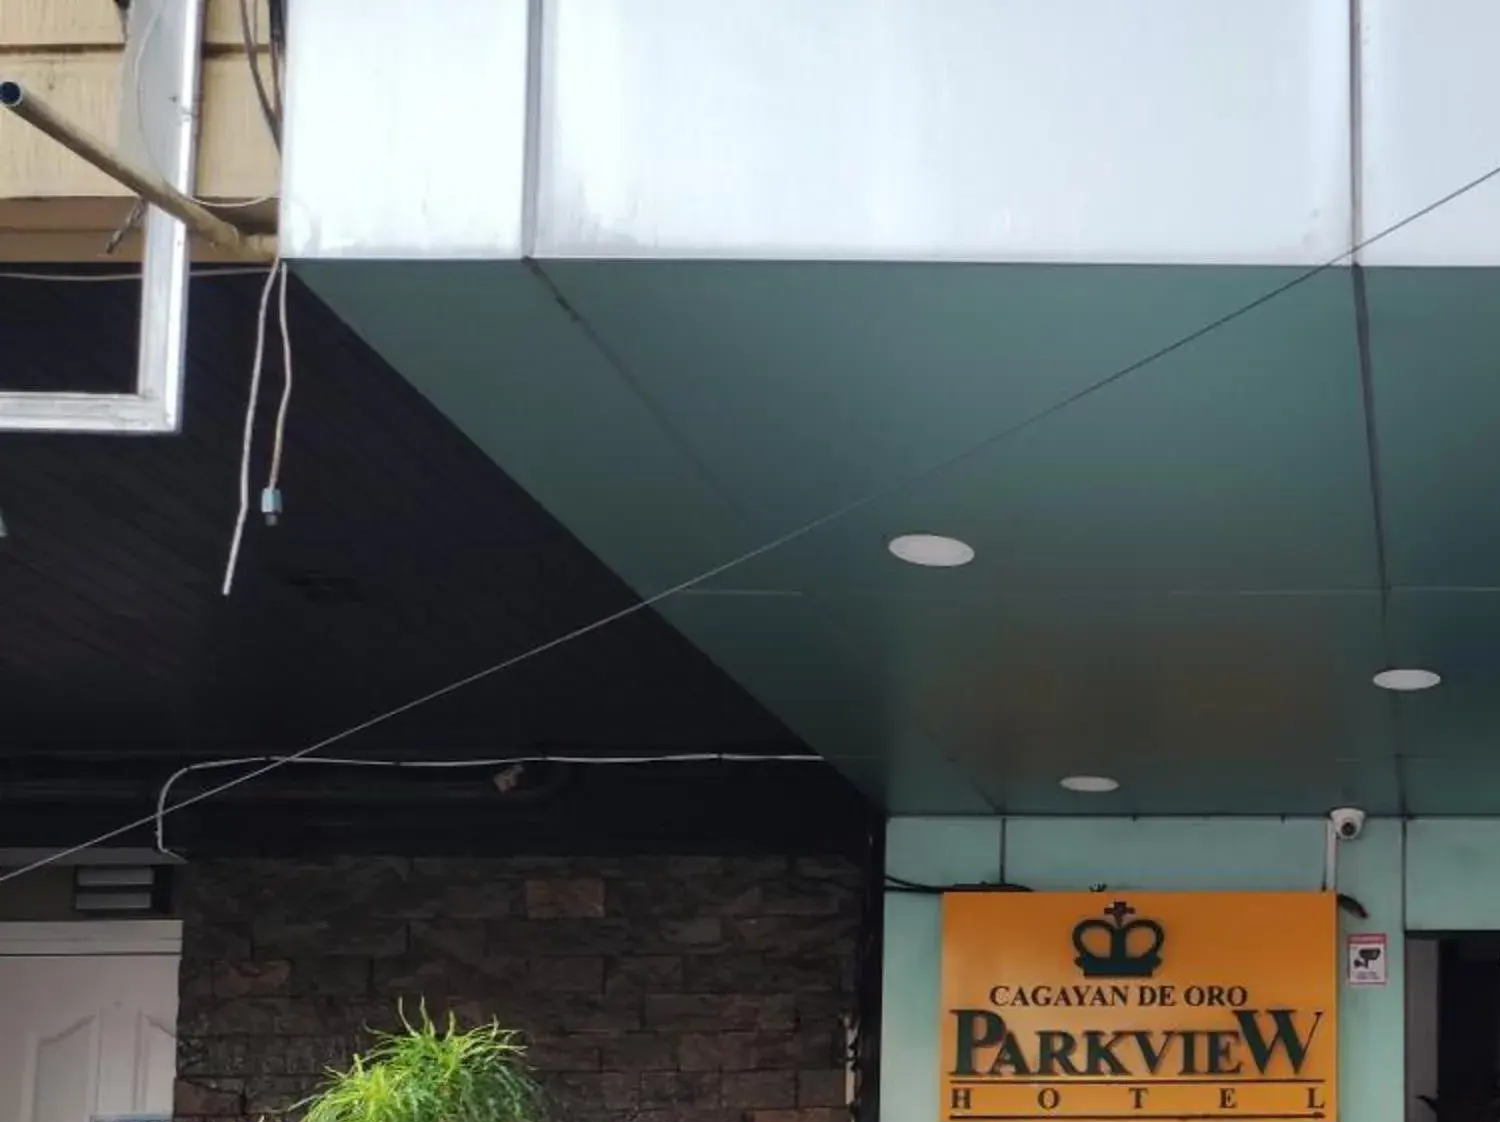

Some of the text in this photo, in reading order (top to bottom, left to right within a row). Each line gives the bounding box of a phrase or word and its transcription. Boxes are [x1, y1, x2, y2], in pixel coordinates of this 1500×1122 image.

[990, 985, 1249, 1007] CAGAYAN DE ORO
[949, 1009, 1325, 1075] PARKVIEW
[951, 1087, 1326, 1110] HOTEL
